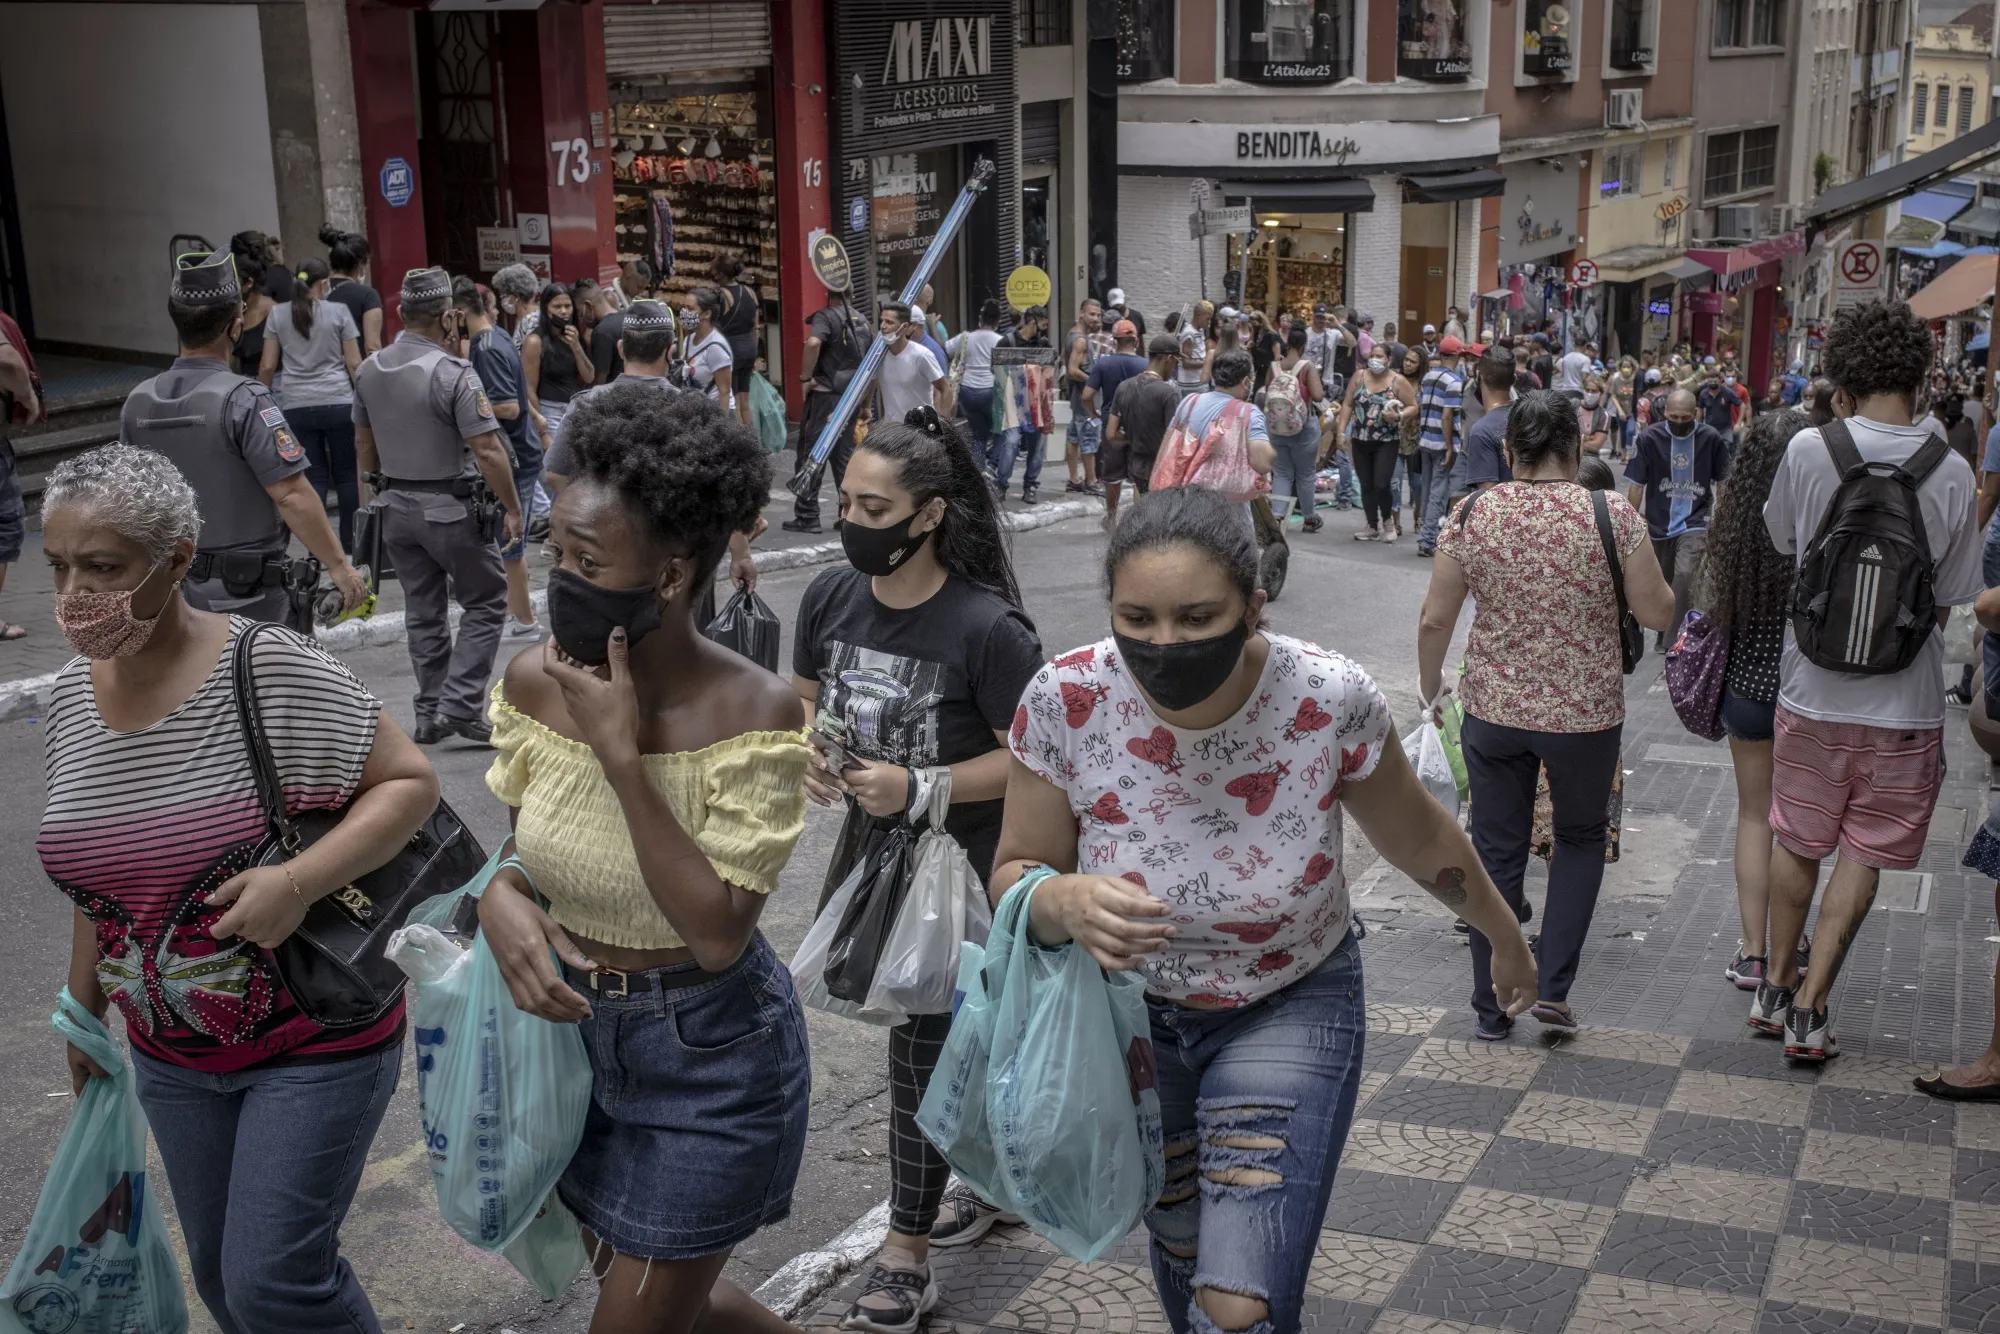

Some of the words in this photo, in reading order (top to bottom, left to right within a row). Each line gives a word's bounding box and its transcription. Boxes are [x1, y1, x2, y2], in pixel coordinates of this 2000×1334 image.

[882, 17, 991, 85] MAXI
[1263, 64, 1331, 77] L'Atelier25
[1237, 131, 1322, 158] BENDITA
[1322, 136, 1361, 165] seja
[551, 138, 590, 186] 73
[849, 159, 865, 180] 79
[803, 157, 821, 188] 75
[1660, 199, 1683, 218] 103
[483, 240, 514, 251] ALUGA
[1008, 280, 1048, 291] LOTEX
[889, 547, 903, 561] NIKE
